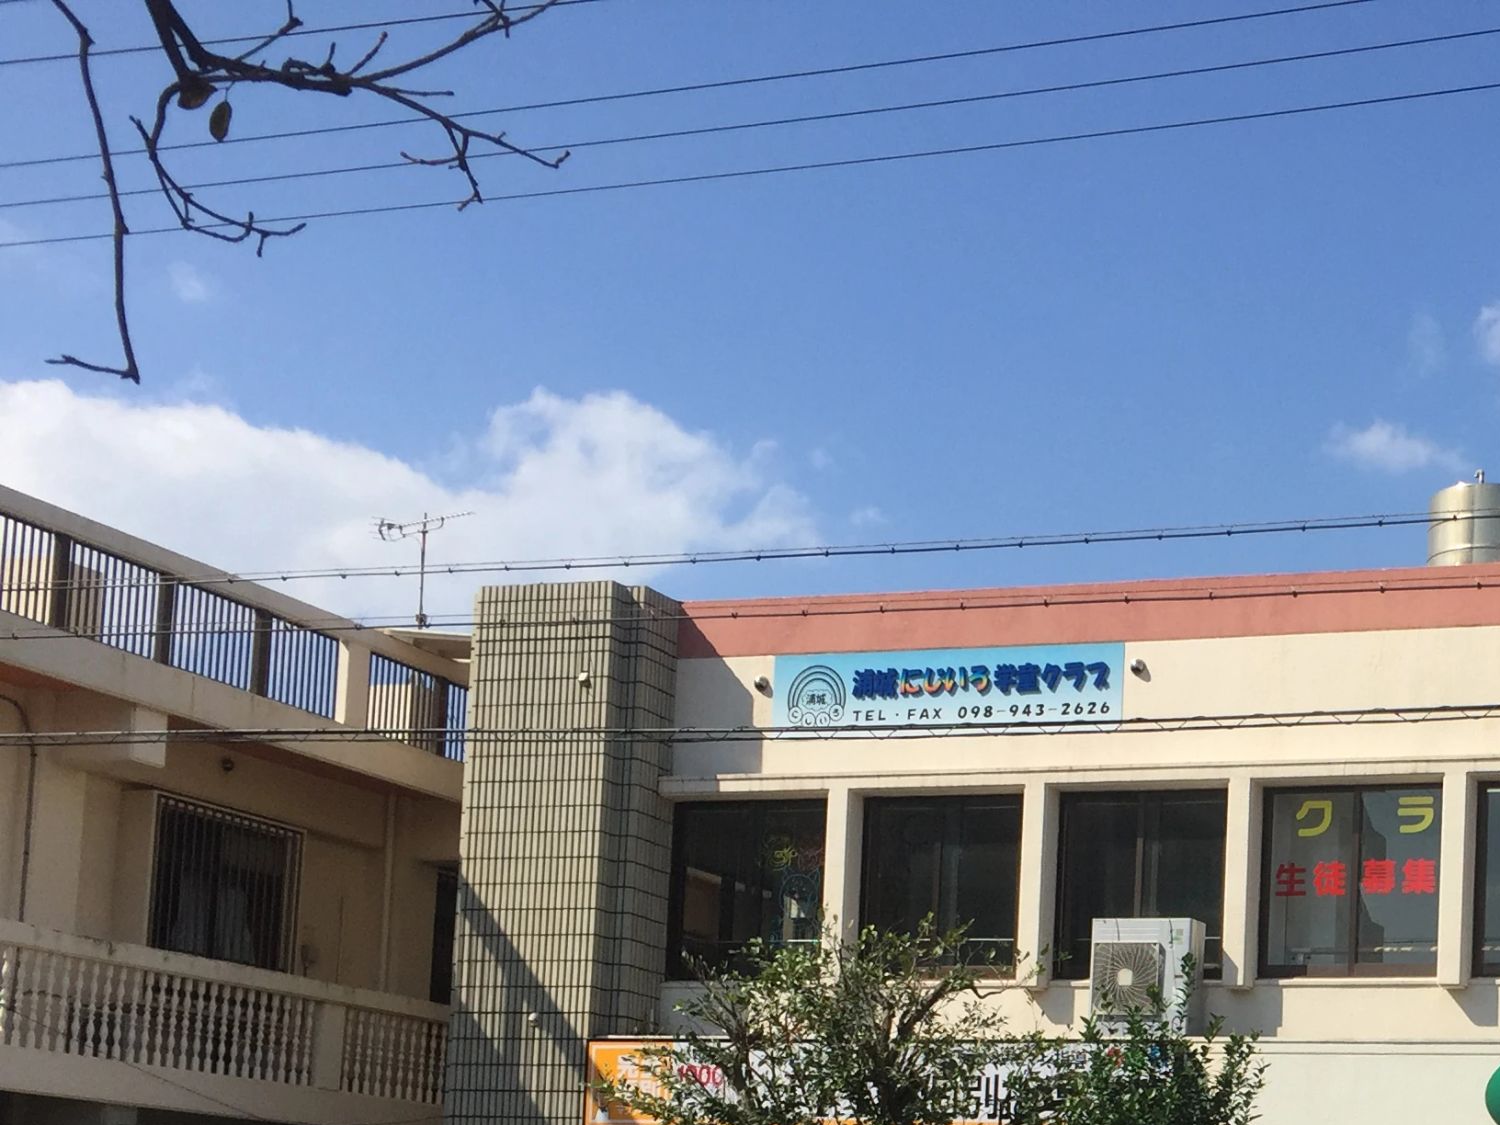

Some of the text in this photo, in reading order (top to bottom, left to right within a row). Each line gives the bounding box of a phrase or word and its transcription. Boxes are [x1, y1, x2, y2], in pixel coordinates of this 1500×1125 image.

[957, 701, 1111, 719] 098-943-2626
[1275, 857, 1437, 897] 生徒募集
